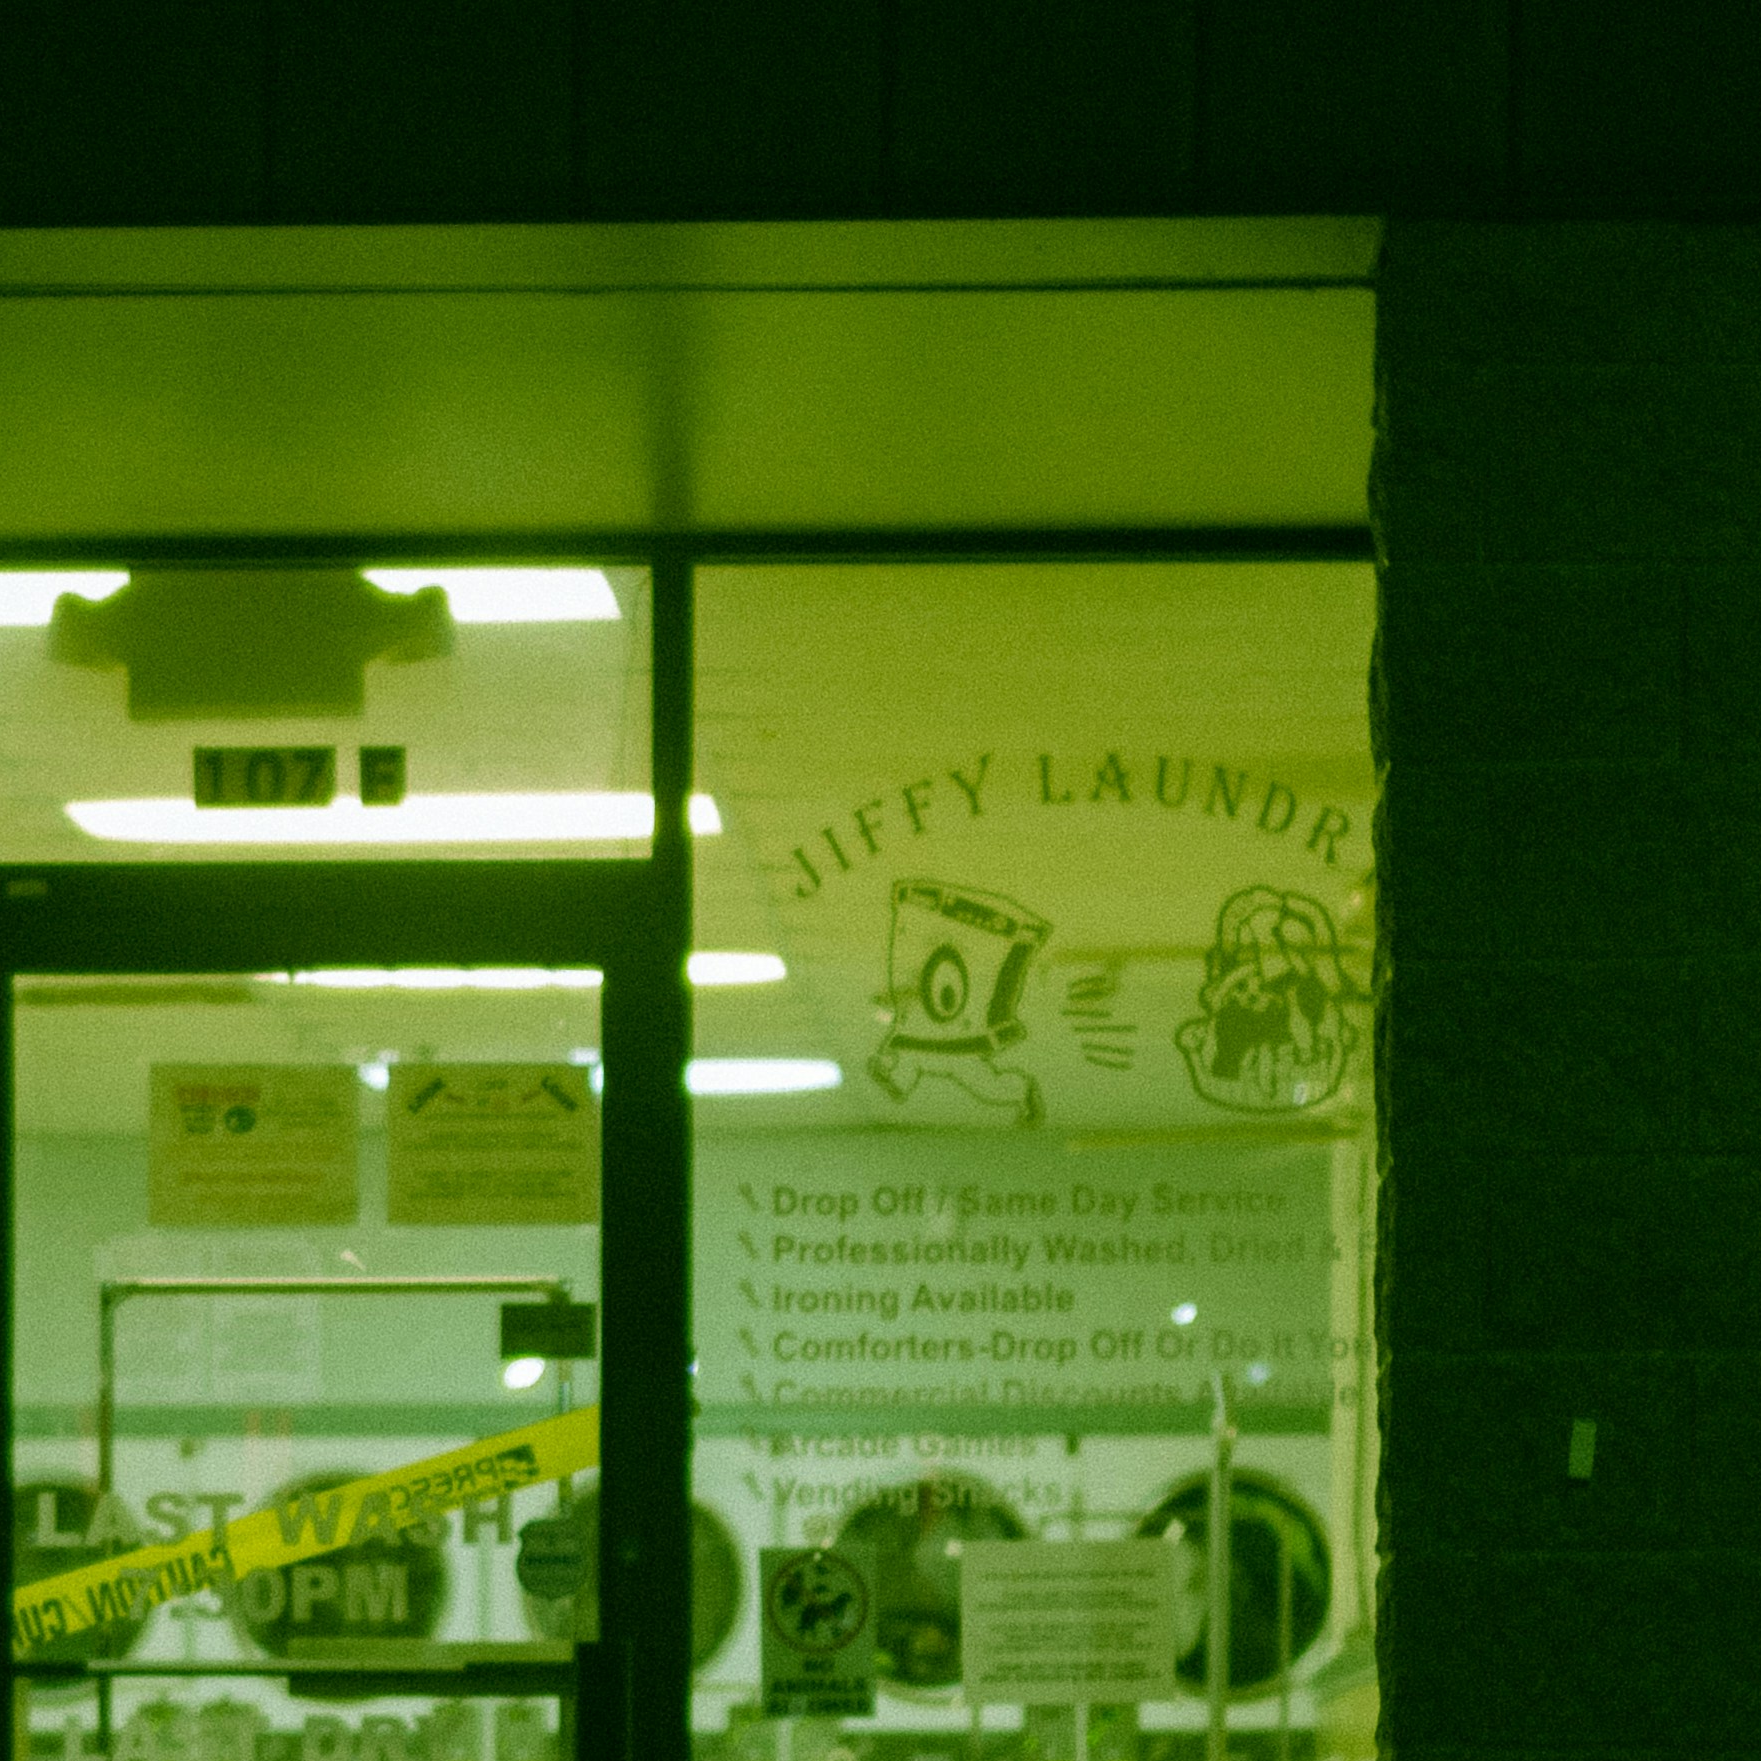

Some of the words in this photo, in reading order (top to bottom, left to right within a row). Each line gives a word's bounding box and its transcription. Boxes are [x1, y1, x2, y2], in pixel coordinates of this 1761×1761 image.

[205, 750, 327, 803] 107
[793, 752, 991, 900] JIFFY
[1040, 752, 1369, 880] LAUNDR
[772, 1183, 861, 1224] Drop
[872, 1183, 926, 1218] Off
[959, 1183, 1058, 1218] Same
[1071, 1182, 1138, 1223] Day
[1152, 1180, 1286, 1217] Service
[772, 1232, 1032, 1274] Professionally
[1207, 1230, 1306, 1265] Dried
[772, 1281, 899, 1322] Ironing
[911, 1281, 1076, 1315] Available
[771, 1327, 1079, 1368] Comforters-Drop
[1091, 1327, 1144, 1362] Off
[1155, 1327, 1202, 1362] Or
[1211, 1328, 1262, 1362] Do
[771, 1378, 989, 1410] Commercial
[38, 1492, 244, 1547] LAST
[273, 1492, 513, 1547] WASH
[772, 1477, 922, 1519] Vending
